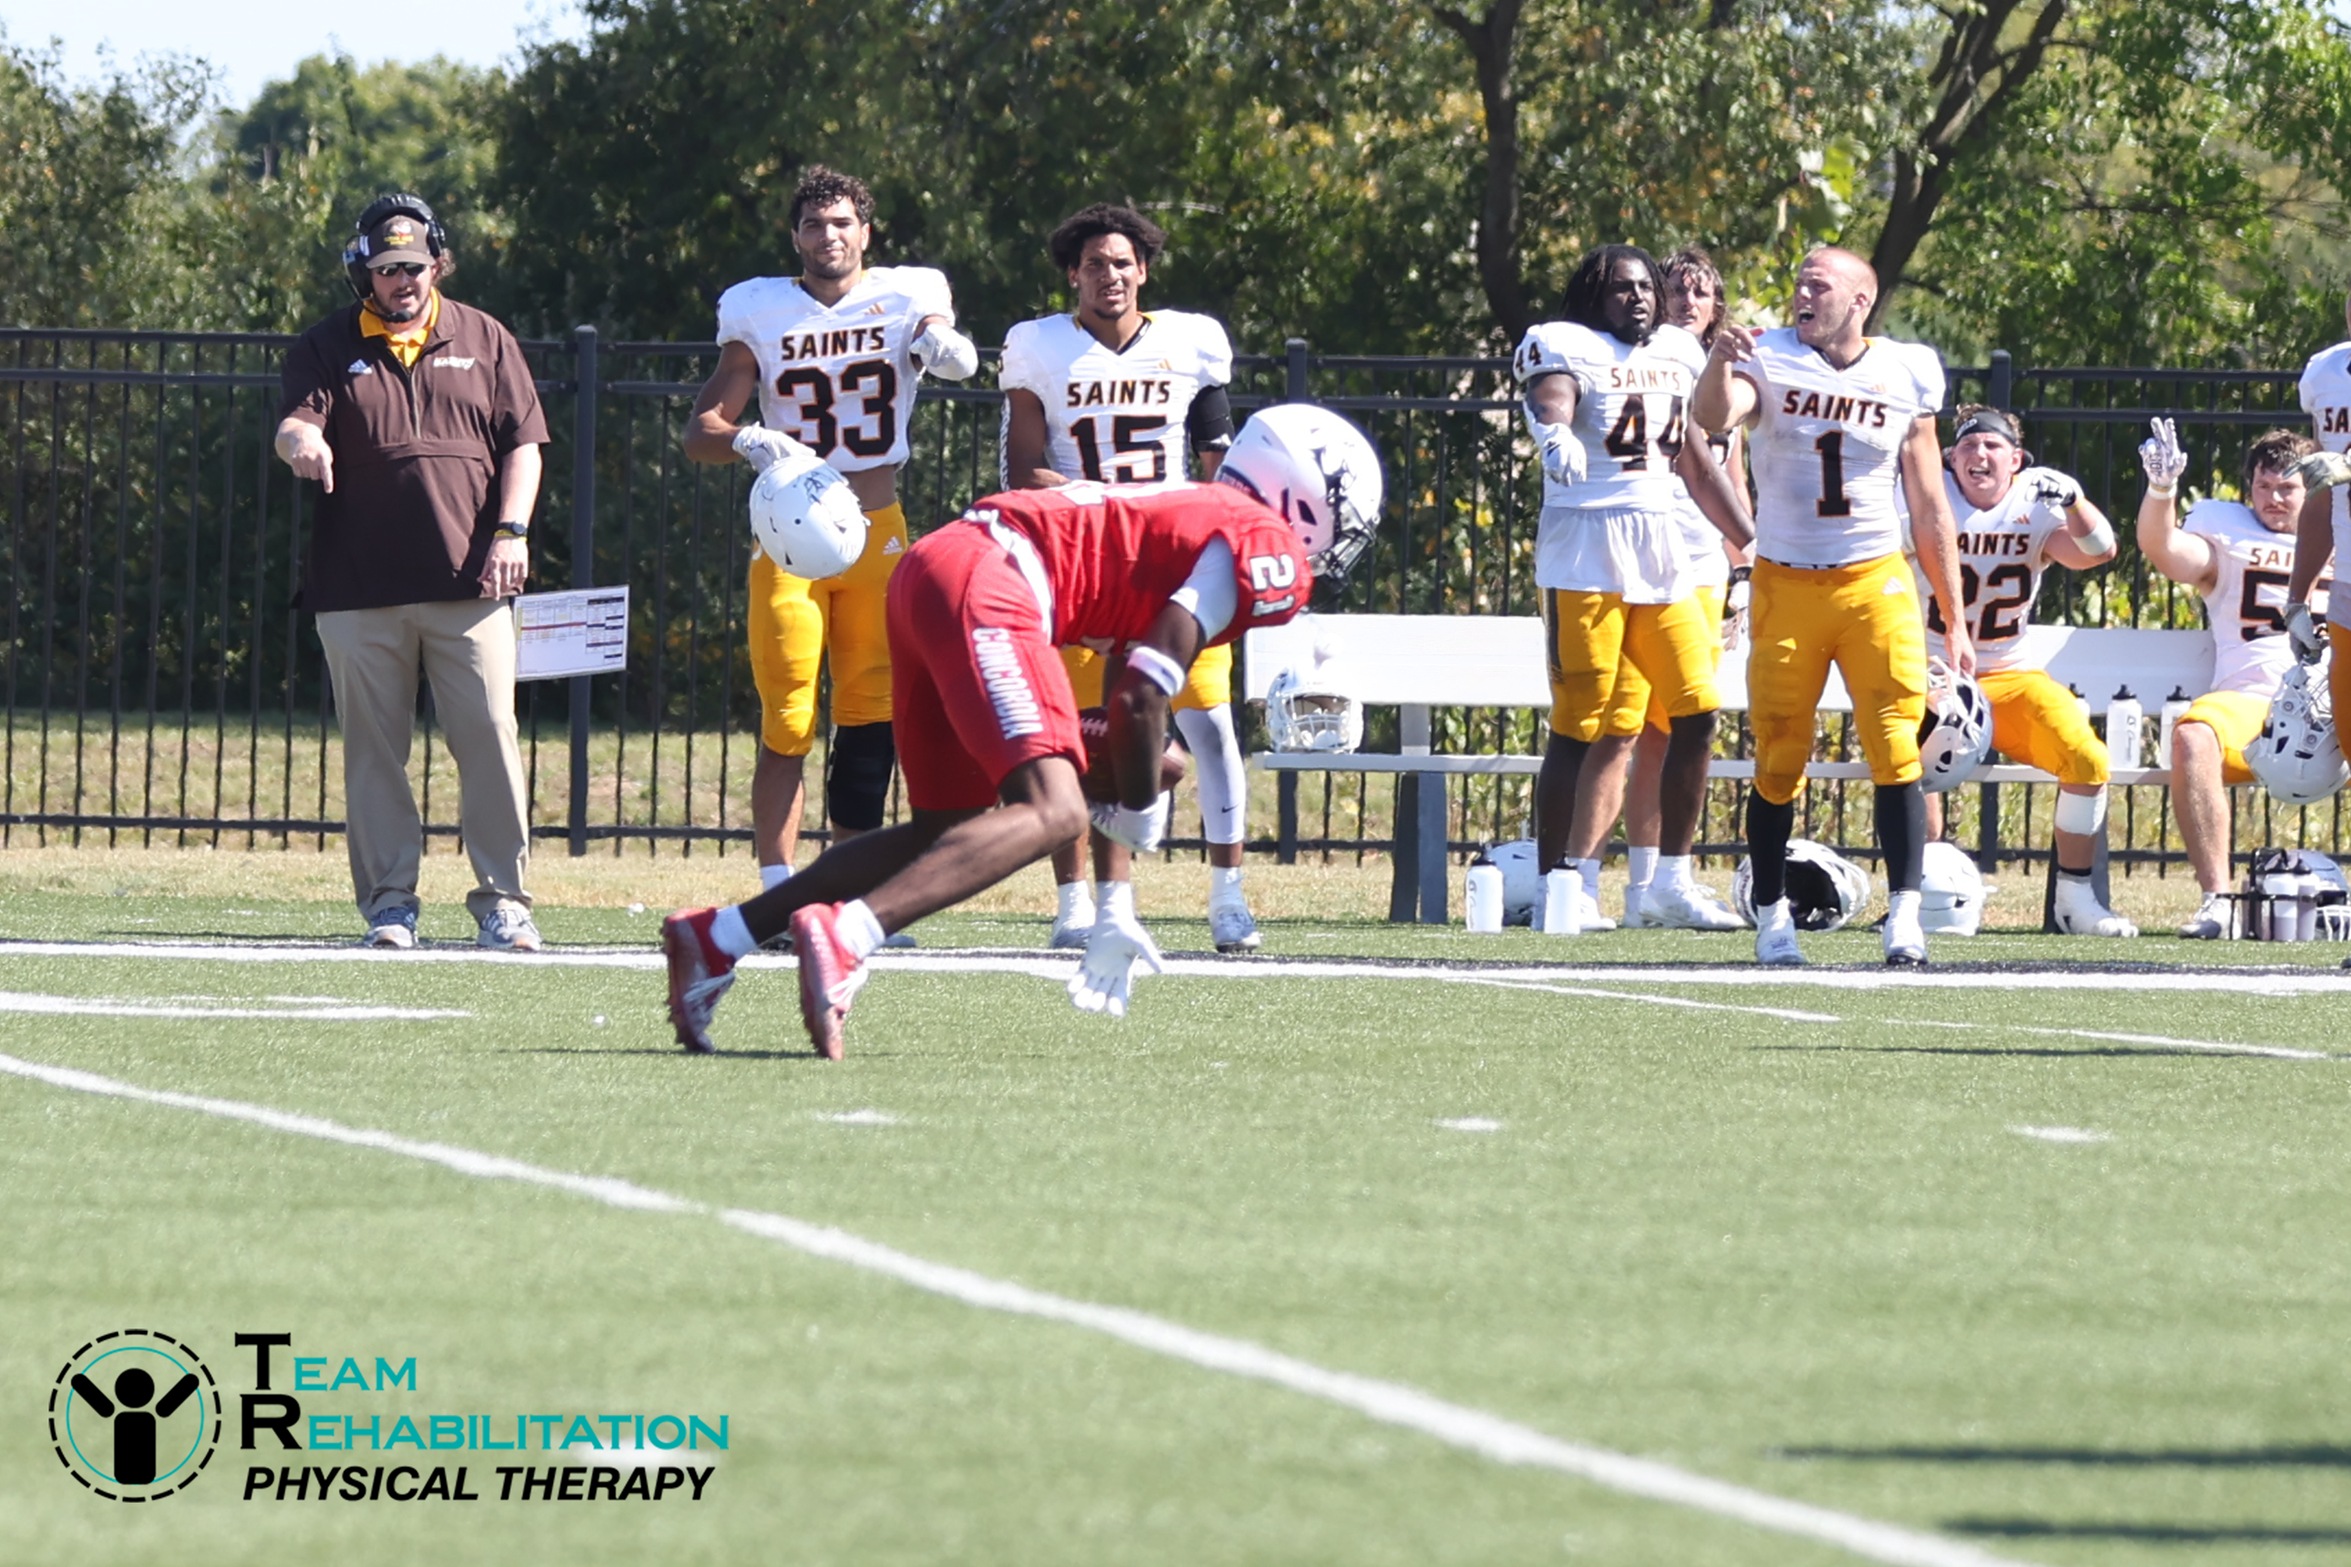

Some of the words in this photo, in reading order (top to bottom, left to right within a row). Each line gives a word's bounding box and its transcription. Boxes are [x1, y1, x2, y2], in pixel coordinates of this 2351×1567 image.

[781, 327, 885, 361] SAINTS
[776, 359, 896, 460] 33
[1067, 380, 1171, 408] SAINTS
[1611, 367, 1680, 390] SAINTS
[1782, 389, 1888, 428] SAINTS
[1069, 414, 1167, 484] 15
[1604, 394, 1684, 473] 44
[1815, 430, 1851, 518] 1
[1957, 532, 2031, 556] AINTS
[1250, 553, 1295, 618] 21
[971, 627, 1044, 740] CONCORDIA
